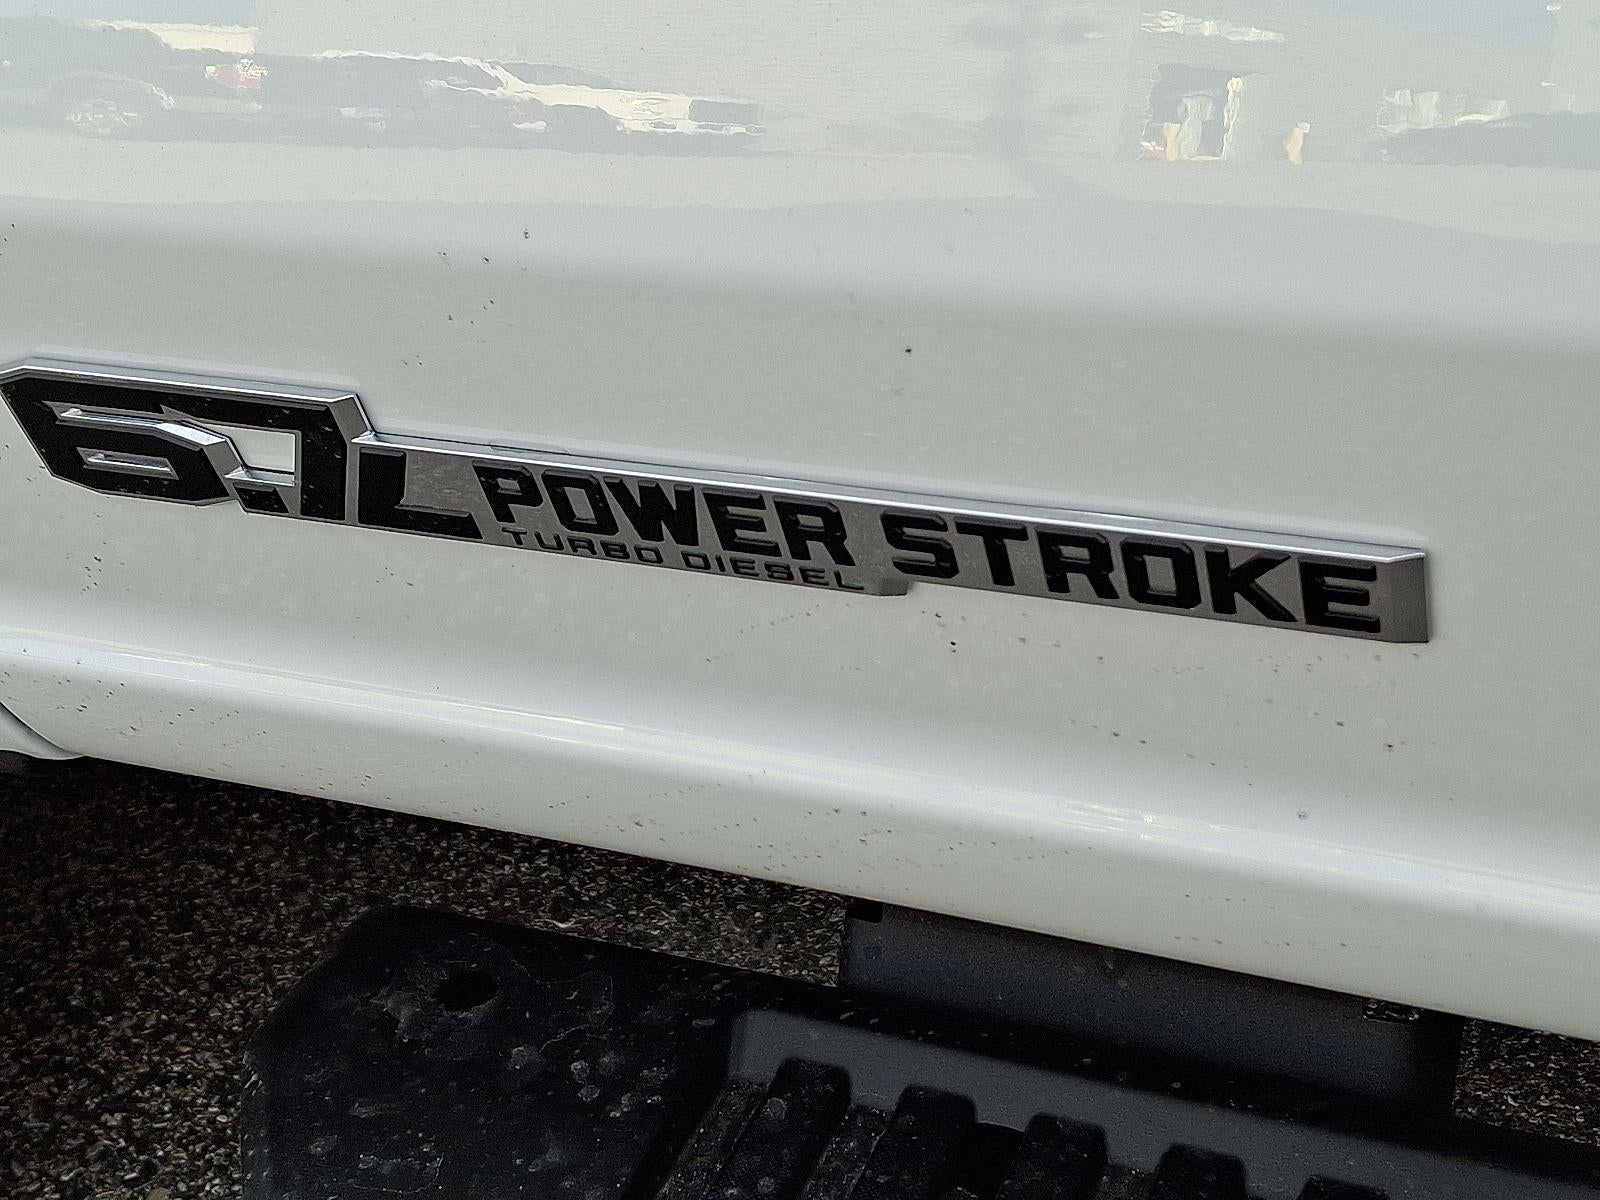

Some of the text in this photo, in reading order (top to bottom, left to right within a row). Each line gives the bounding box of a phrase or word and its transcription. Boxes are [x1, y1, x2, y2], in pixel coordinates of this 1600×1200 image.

[472, 459, 856, 567] POWER
[880, 509, 1382, 634] STROKE
[501, 526, 865, 591] TURBO DIESEL
